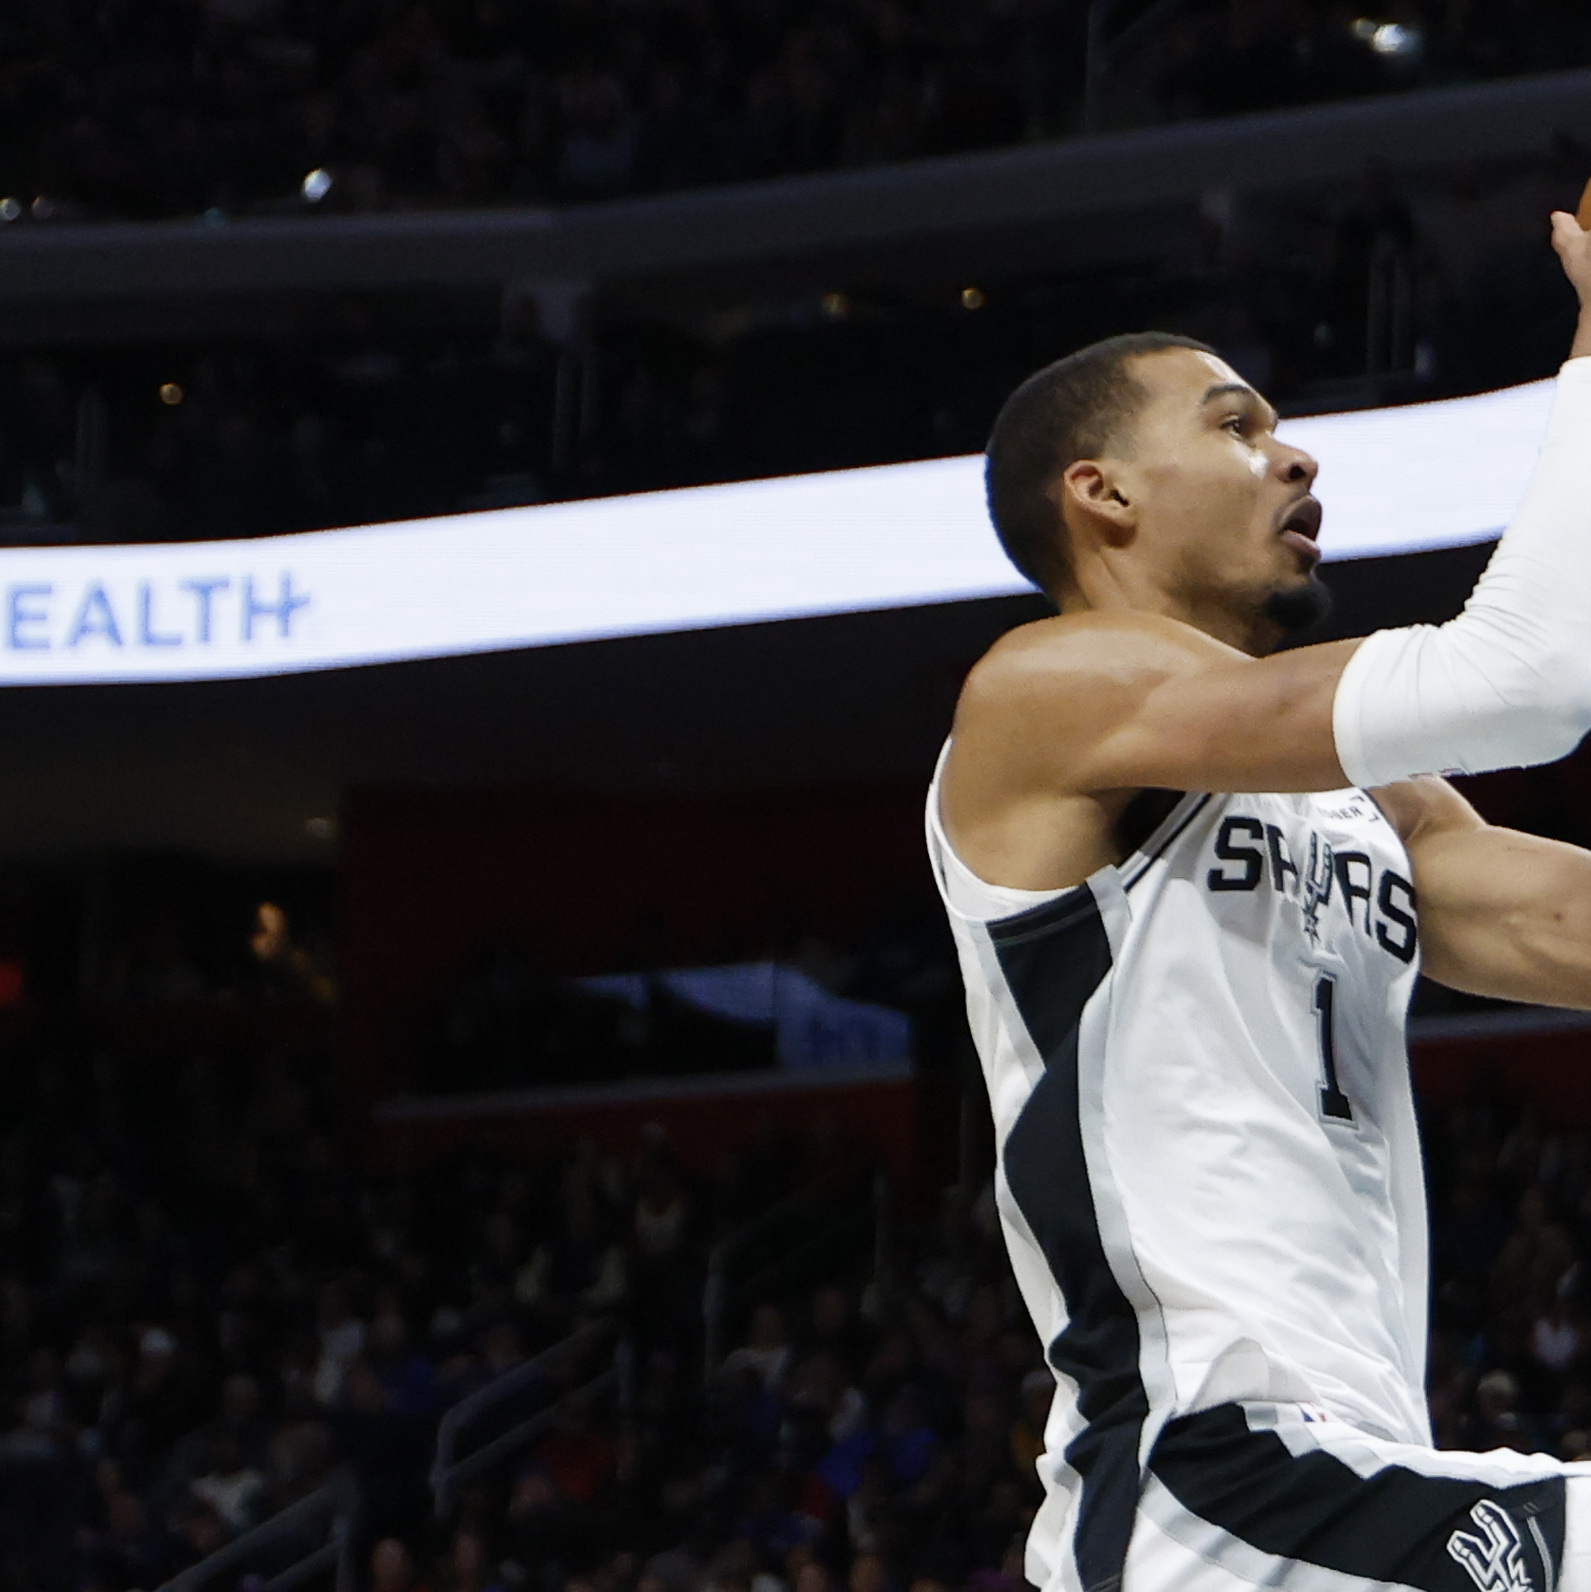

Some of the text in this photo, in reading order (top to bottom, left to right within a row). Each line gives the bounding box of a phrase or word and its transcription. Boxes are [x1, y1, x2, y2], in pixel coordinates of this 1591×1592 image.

[3, 572, 311, 653] EALTH
[1207, 815, 1418, 964] SPURS
[1308, 970, 1359, 1130] 1
